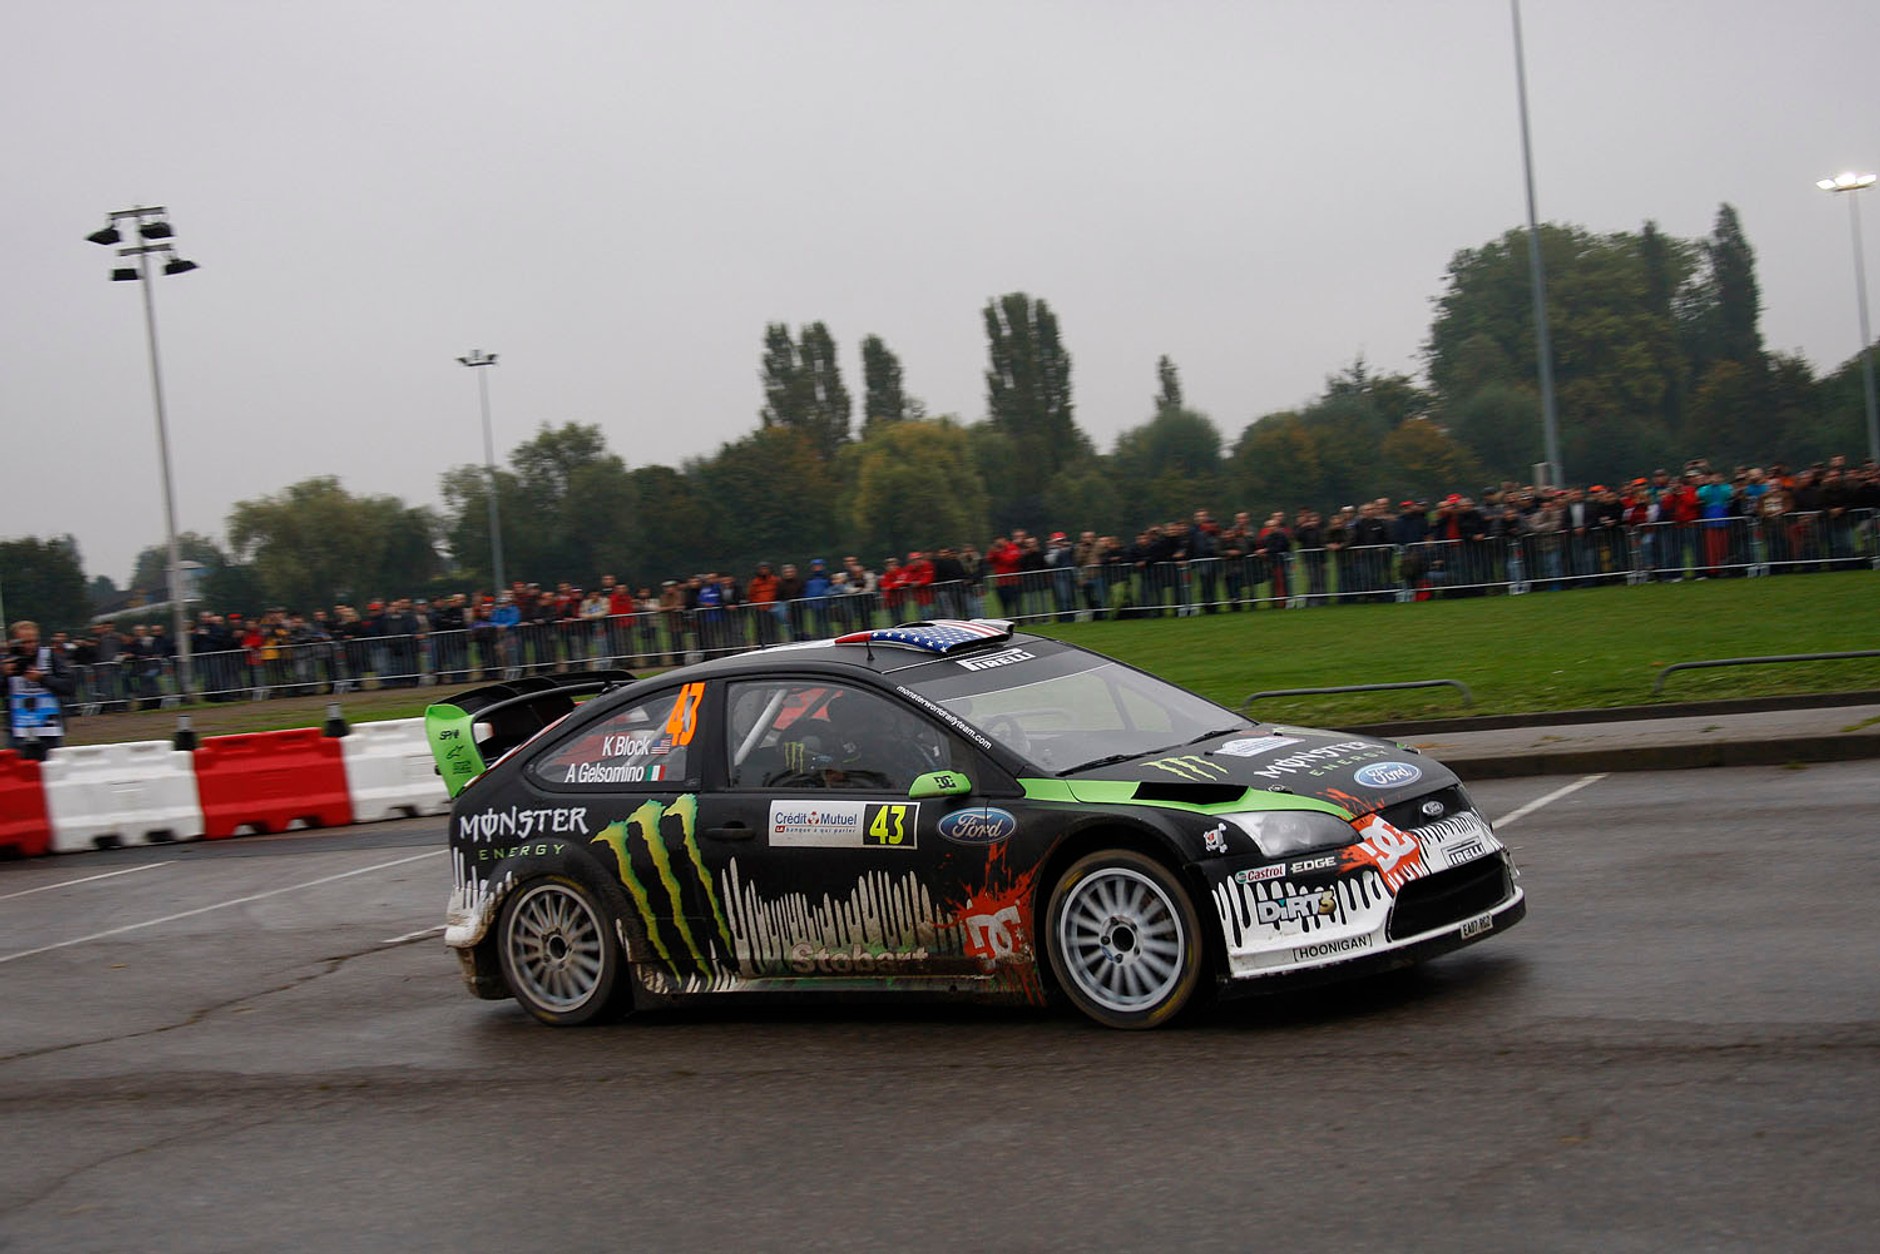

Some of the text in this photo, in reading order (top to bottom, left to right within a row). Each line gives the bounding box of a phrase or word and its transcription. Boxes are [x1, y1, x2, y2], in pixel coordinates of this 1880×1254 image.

[955, 647, 1036, 672] PIRELLI
[665, 682, 706, 747] 43
[896, 685, 992, 750] monsterworldrallyteam.com
[602, 735, 651, 756] K Block
[564, 762, 645, 783] A Gelsomino
[1308, 750, 1390, 777] ENERGY
[1367, 764, 1413, 785] Ford
[459, 806, 590, 843] MONSTER
[775, 811, 857, 825] Crédit Mutuel
[869, 805, 906, 845] 43
[952, 813, 1003, 838] Ford
[479, 844, 565, 861] ENERGY
[1247, 856, 1336, 882] Castrol EDGE
